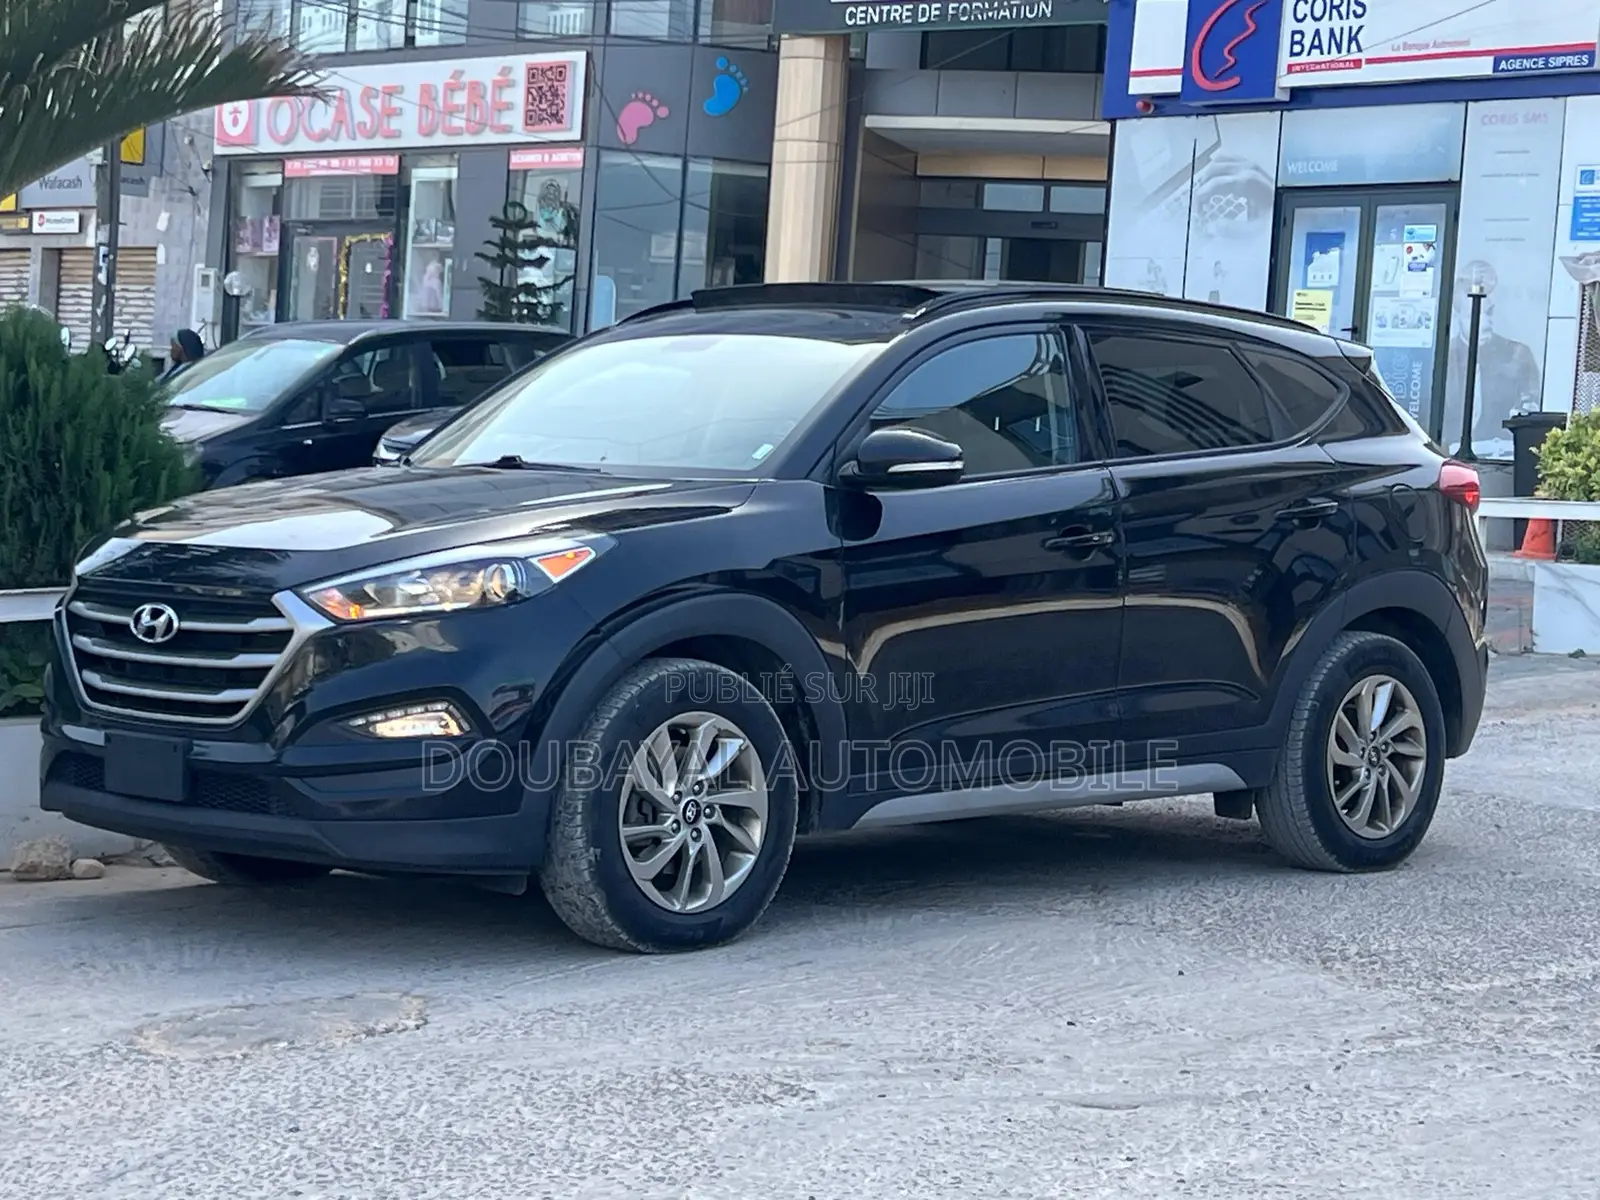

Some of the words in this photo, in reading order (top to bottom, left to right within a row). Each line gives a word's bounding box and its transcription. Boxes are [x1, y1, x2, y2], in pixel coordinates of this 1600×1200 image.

[845, 4, 914, 25] CENTRE
[918, 4, 942, 23] DE
[947, 0, 1053, 22] FORMATION
[1293, 0, 1367, 23] CORIS
[1289, 25, 1365, 57] BANK
[1499, 56, 1545, 70] AGENCE
[1547, 54, 1590, 68] SIPRES
[417, 65, 517, 137] BÉBÉ
[1287, 160, 1338, 174] WELCOME
[39, 175, 82, 190] Wafacash
